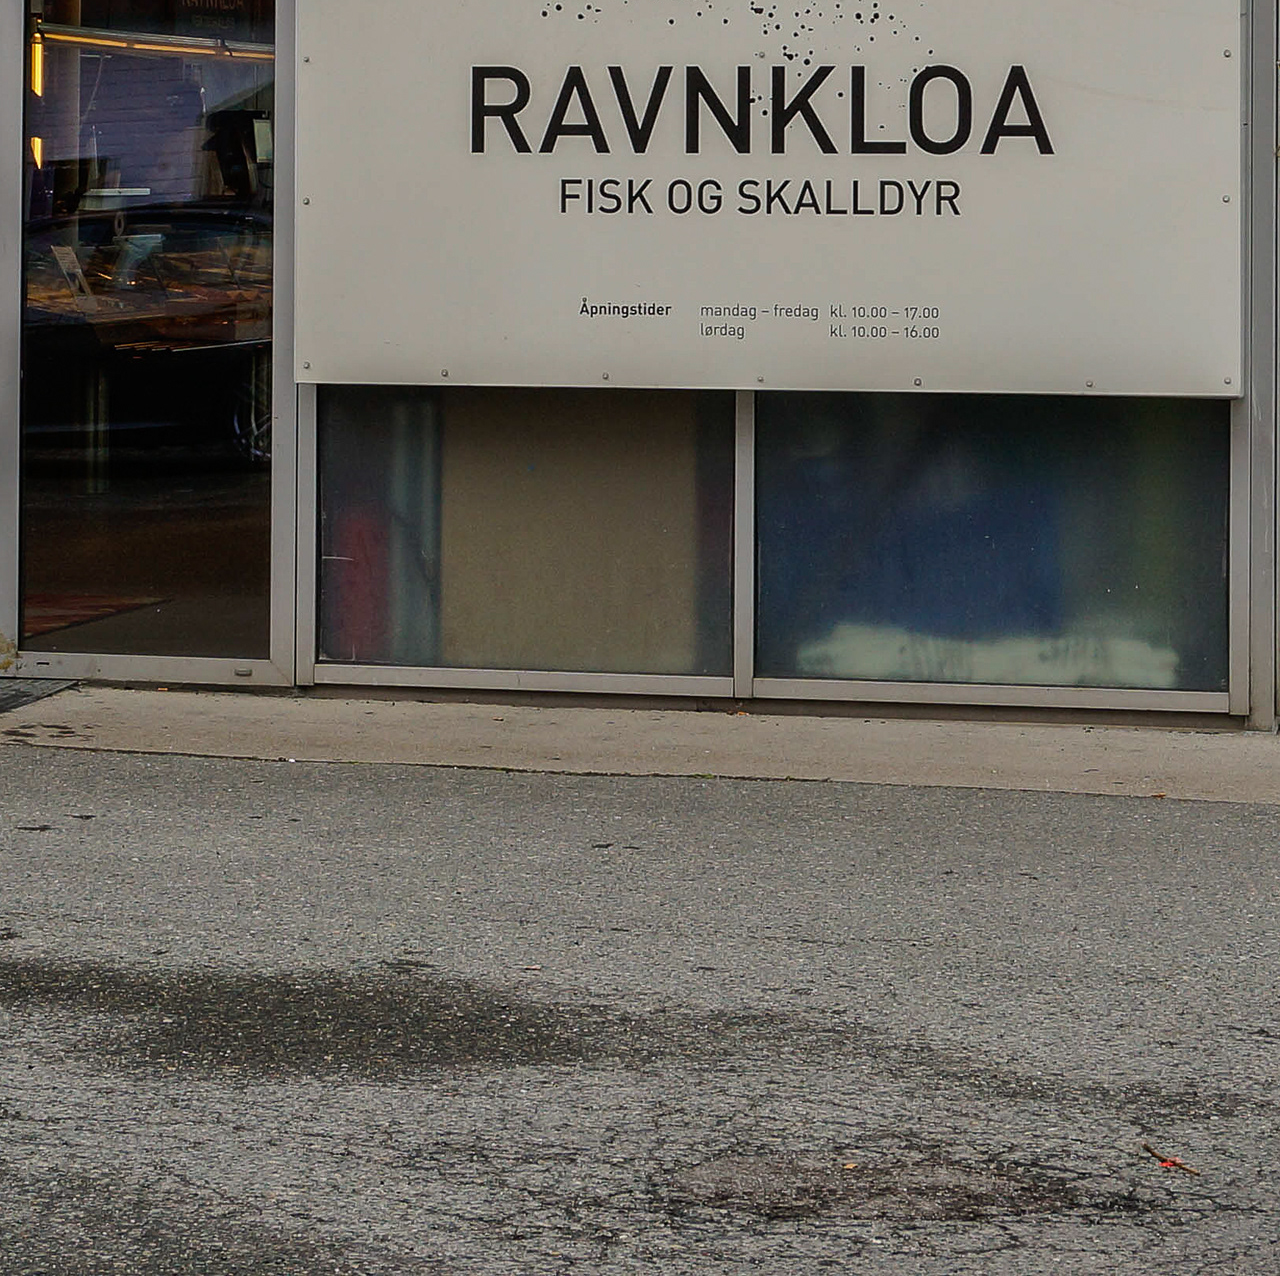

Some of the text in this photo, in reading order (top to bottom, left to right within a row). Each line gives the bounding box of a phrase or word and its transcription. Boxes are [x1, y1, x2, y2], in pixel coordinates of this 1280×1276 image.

[471, 65, 1055, 155] RAVNKLOA
[560, 178, 961, 216] FISK OG SKALLDYR
[579, 297, 673, 319] Åpningstider
[700, 304, 757, 320] mandag
[773, 304, 819, 321] fredag
[830, 304, 847, 318] kl.
[851, 306, 887, 319] 10.00
[904, 306, 939, 320] 17.00
[700, 322, 745, 340] lørdag
[830, 324, 847, 338] kl.
[851, 325, 887, 338] 10.00
[904, 325, 940, 339] 16.00
